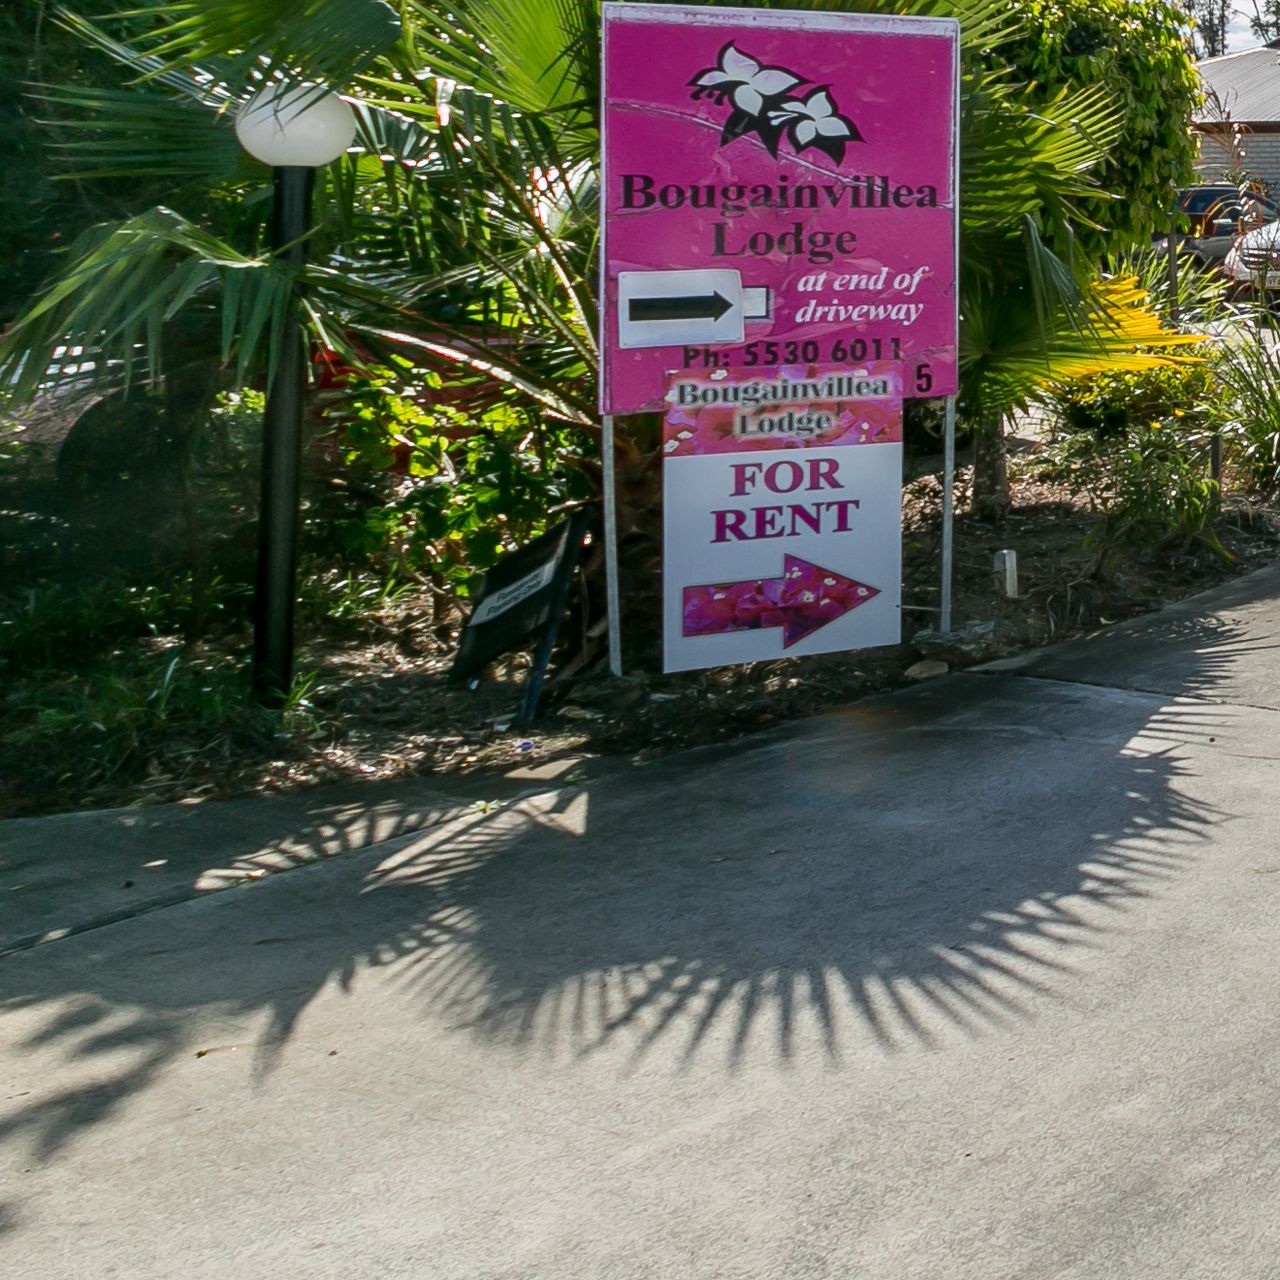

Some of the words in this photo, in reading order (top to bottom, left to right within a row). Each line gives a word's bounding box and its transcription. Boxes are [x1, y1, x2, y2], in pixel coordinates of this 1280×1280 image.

[619, 174, 939, 218] Bougainvillea
[711, 222, 857, 263] Lodge
[797, 271, 828, 292] at
[832, 266, 889, 291] end
[893, 265, 930, 296] of
[795, 298, 924, 326] driveway
[682, 344, 731, 368] Ph:
[743, 340, 819, 366] 5530
[831, 337, 901, 363] 6011
[676, 375, 889, 407] Bougainvillea
[915, 364, 933, 393] 5
[739, 410, 833, 438] Lodge
[729, 458, 845, 497] FOR
[709, 499, 860, 544] RENT
